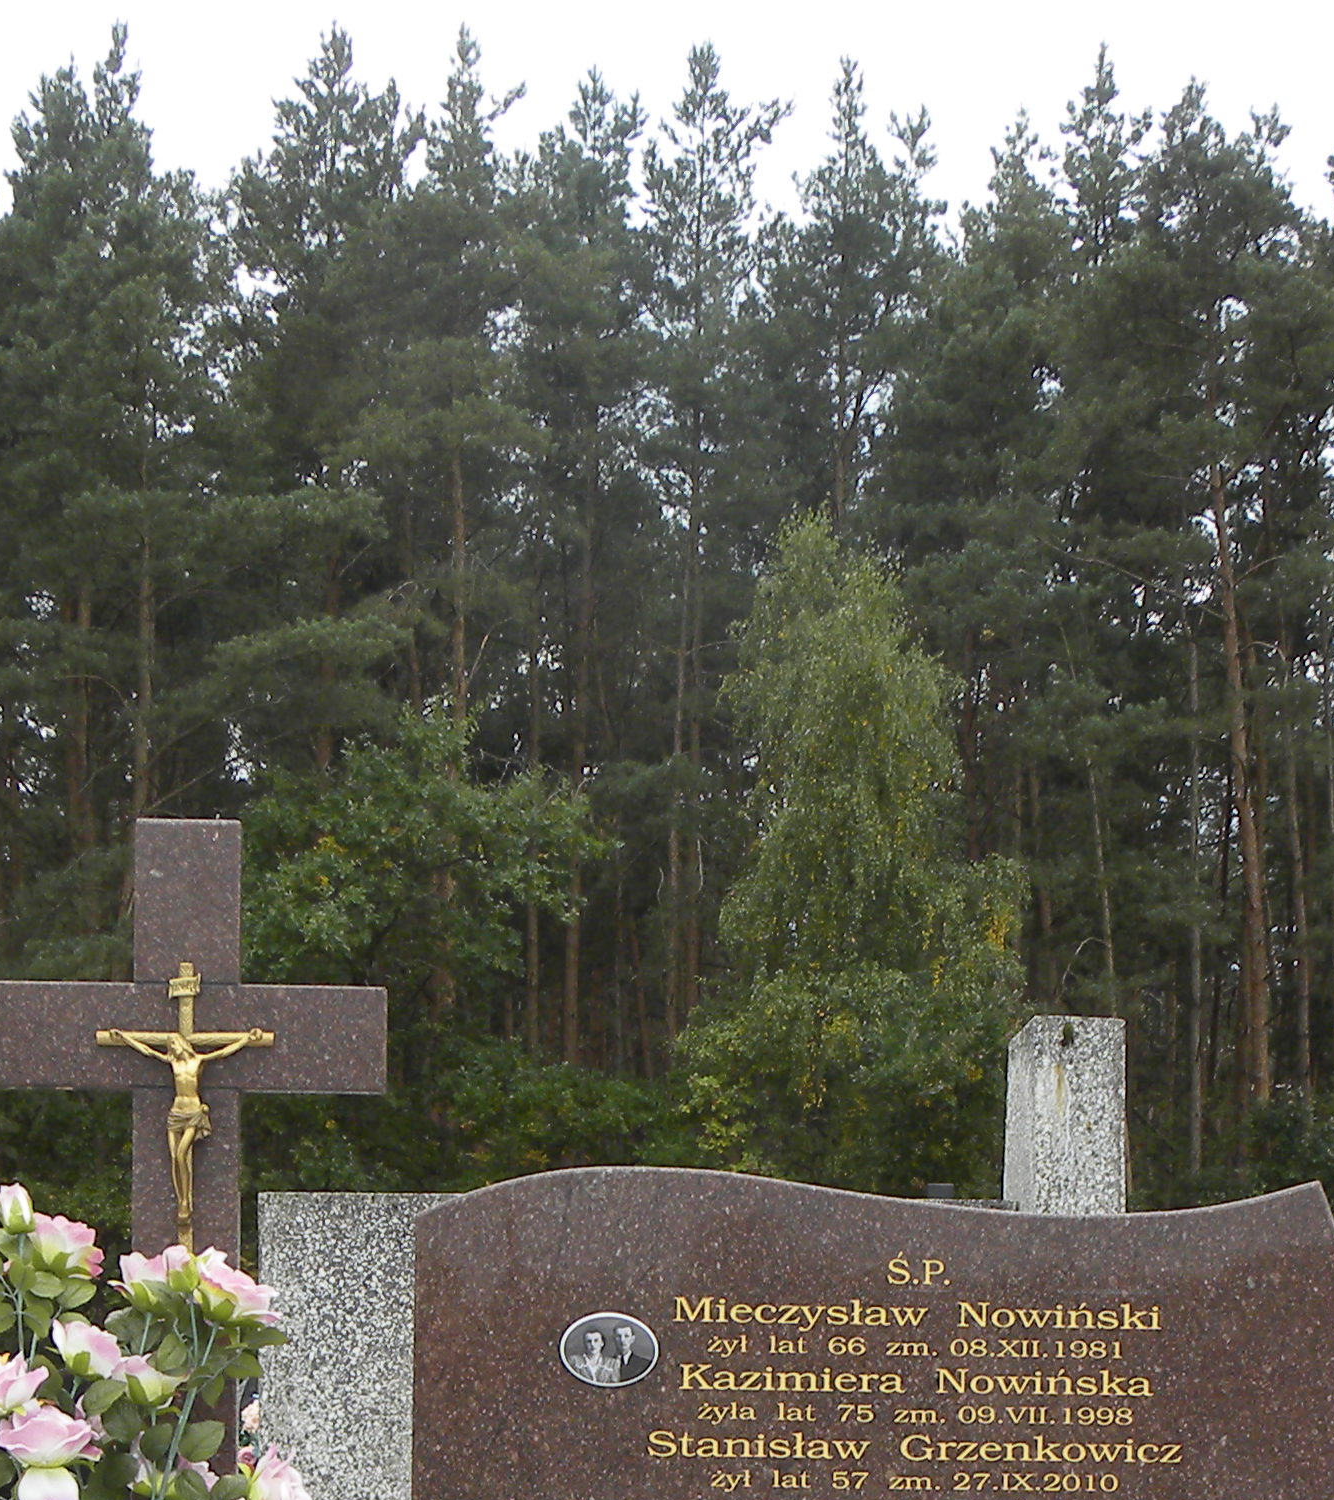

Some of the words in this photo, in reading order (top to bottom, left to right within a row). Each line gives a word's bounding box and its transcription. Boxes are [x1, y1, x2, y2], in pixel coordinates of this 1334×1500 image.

[886, 1250, 951, 1286] Ś.P.
[673, 1296, 929, 1332] Mieczysław
[958, 1301, 1162, 1330] Nowiński
[707, 1334, 748, 1358] żył
[769, 1335, 809, 1354] lat
[827, 1336, 867, 1356] 66
[886, 1342, 938, 1356] zm.
[949, 1338, 1123, 1359] 08.XII.1981
[678, 1363, 906, 1394] Kazimiera
[935, 1367, 1154, 1397] Nowińska
[697, 1401, 757, 1426] żyła
[778, 1402, 817, 1422] lat
[838, 1403, 874, 1422] 75
[894, 1409, 946, 1425] zm.
[957, 1405, 1133, 1426] 09.VII.1998
[647, 1430, 871, 1460] Stanisław
[899, 1434, 1183, 1464] Grzenkowicz
[711, 1468, 752, 1492] żył
[772, 1469, 810, 1488] lat
[832, 1471, 869, 1490] 57
[889, 1476, 941, 1490] zm.
[953, 1472, 1119, 1492] 27.IX.2010
